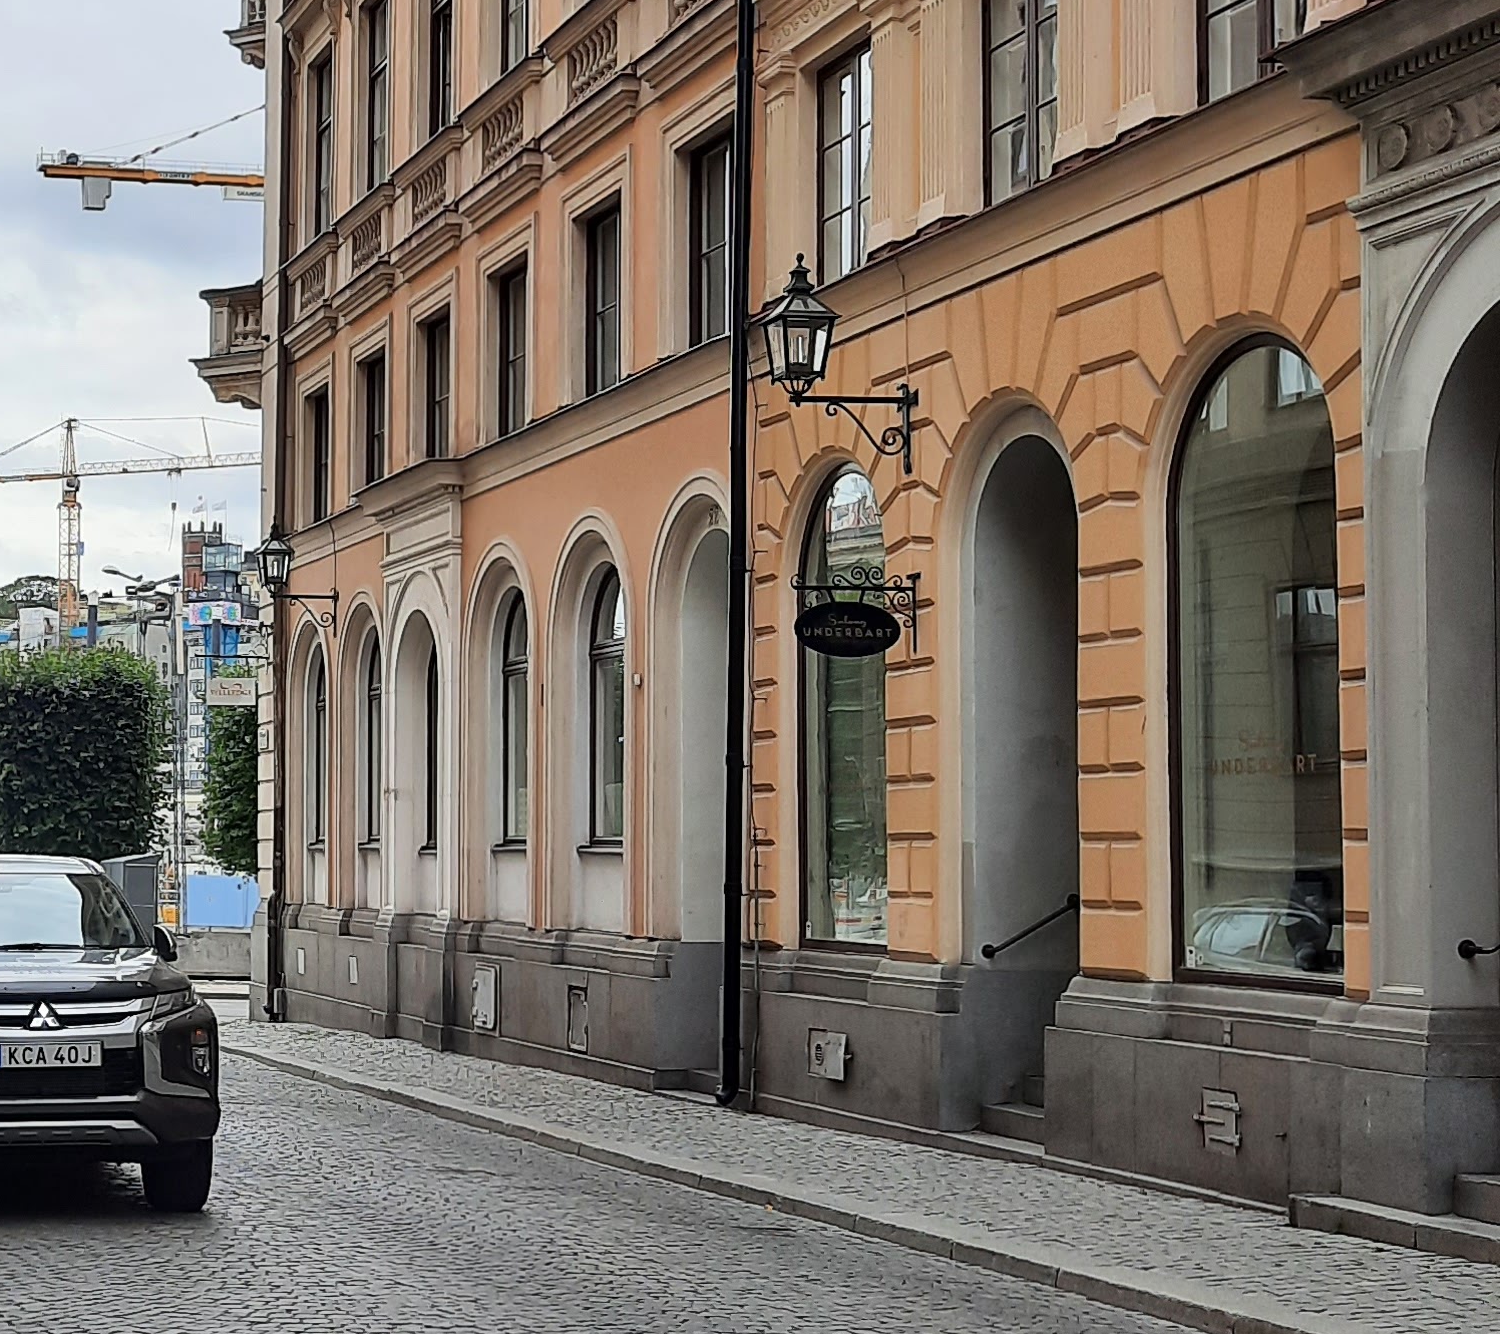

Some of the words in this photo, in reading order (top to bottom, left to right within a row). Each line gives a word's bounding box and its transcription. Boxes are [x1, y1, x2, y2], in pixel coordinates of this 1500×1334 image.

[803, 627, 893, 638] UNDERBART
[8, 1046, 47, 1065] KCA
[54, 1045, 92, 1064] 40J
